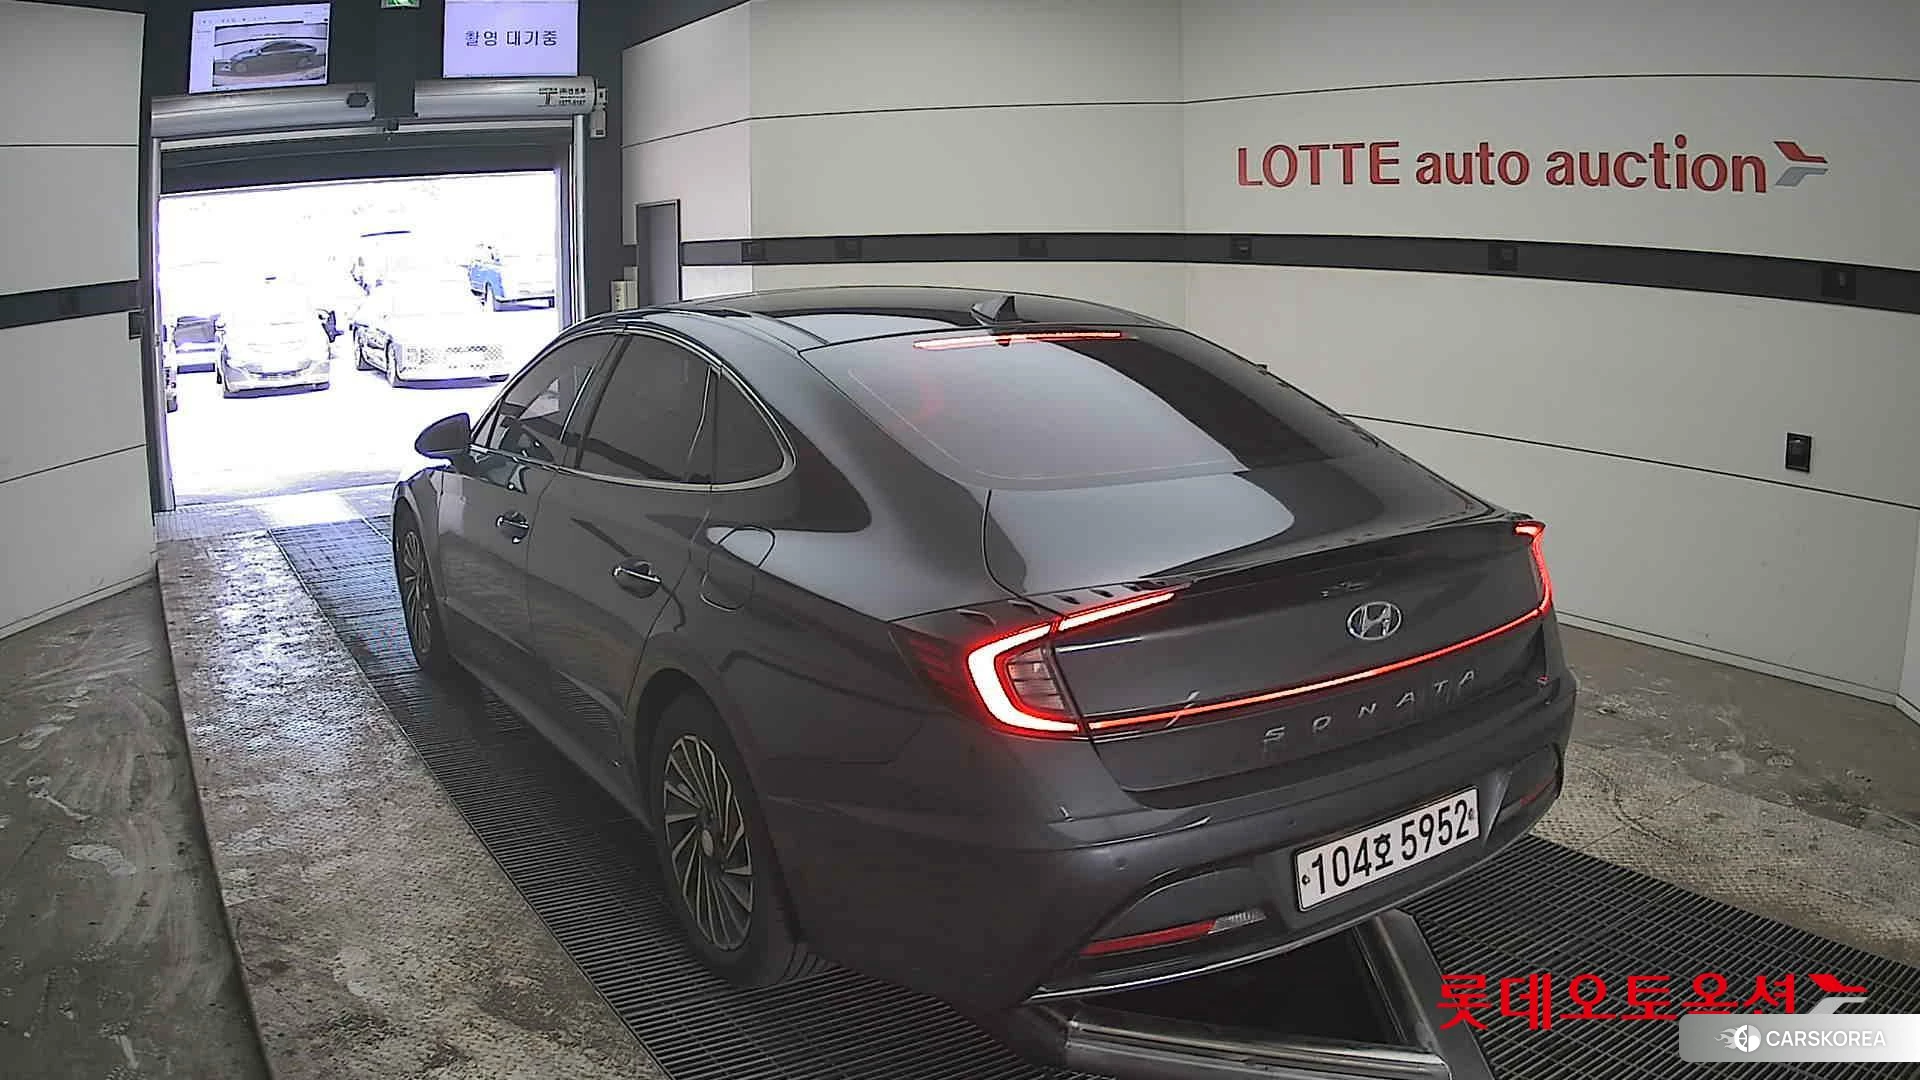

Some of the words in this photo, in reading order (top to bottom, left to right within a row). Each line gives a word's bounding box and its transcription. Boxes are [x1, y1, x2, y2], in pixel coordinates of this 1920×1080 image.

[506, 30, 557, 46] 대기중
[1237, 141, 1400, 187] LOTTE
[1415, 142, 1530, 185] auto
[1545, 135, 1767, 193] auction
[1262, 669, 1475, 743] SONATA
